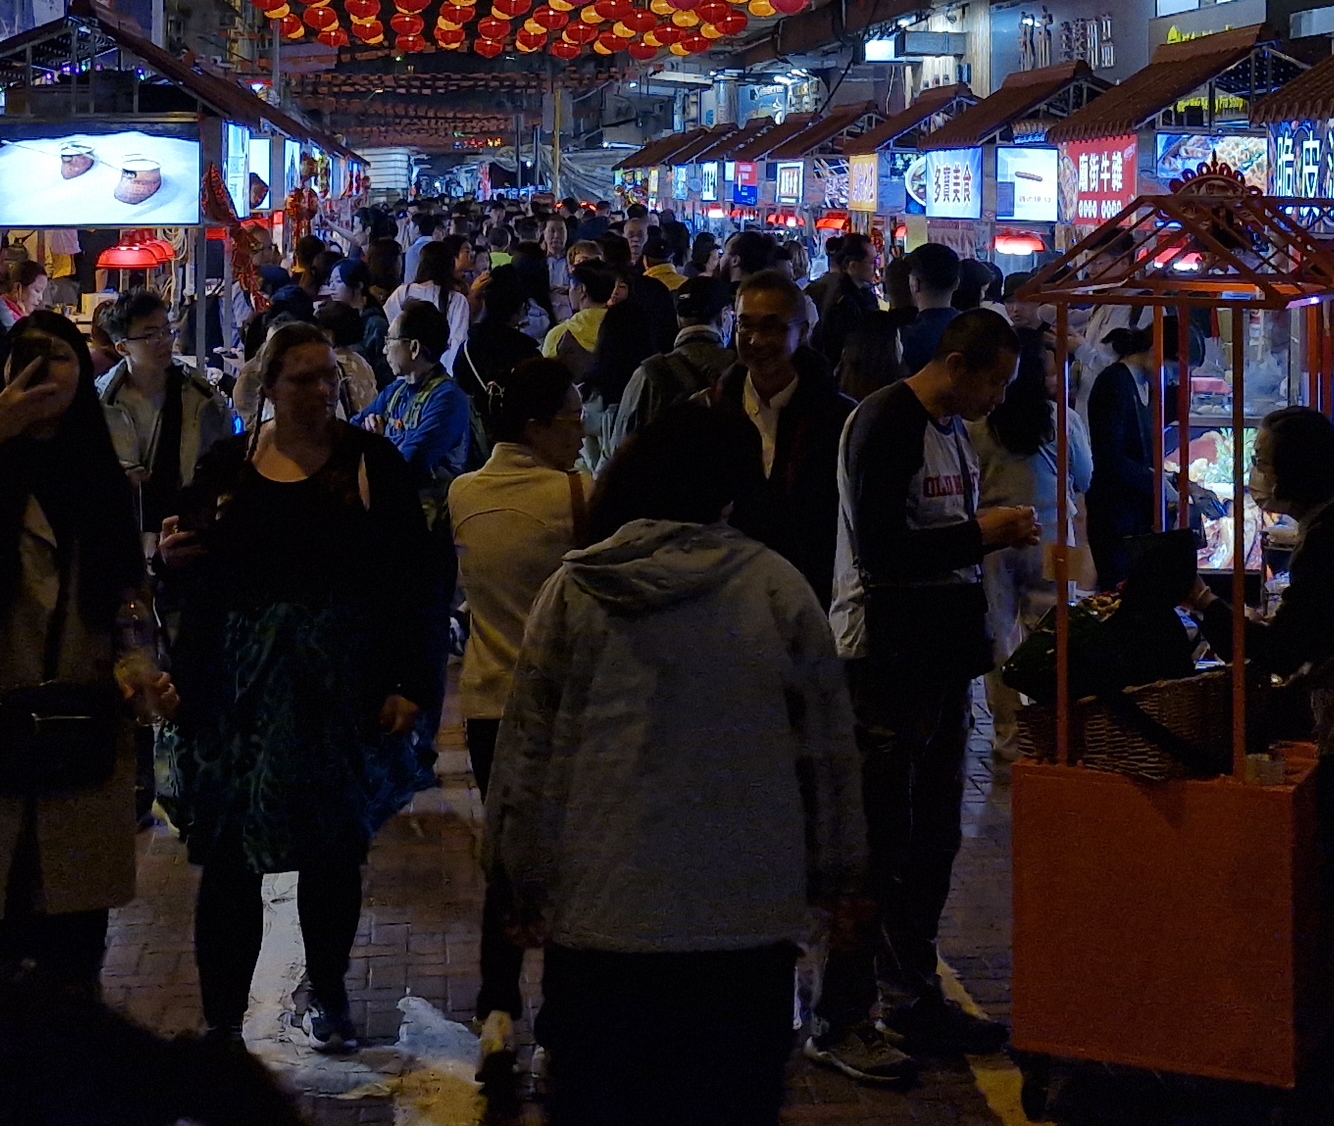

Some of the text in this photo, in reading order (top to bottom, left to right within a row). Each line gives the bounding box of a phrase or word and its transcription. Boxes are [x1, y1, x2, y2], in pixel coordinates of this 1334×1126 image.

[933, 161, 972, 204] 多寶美食
[1078, 151, 1123, 192] 廟街牛雜
